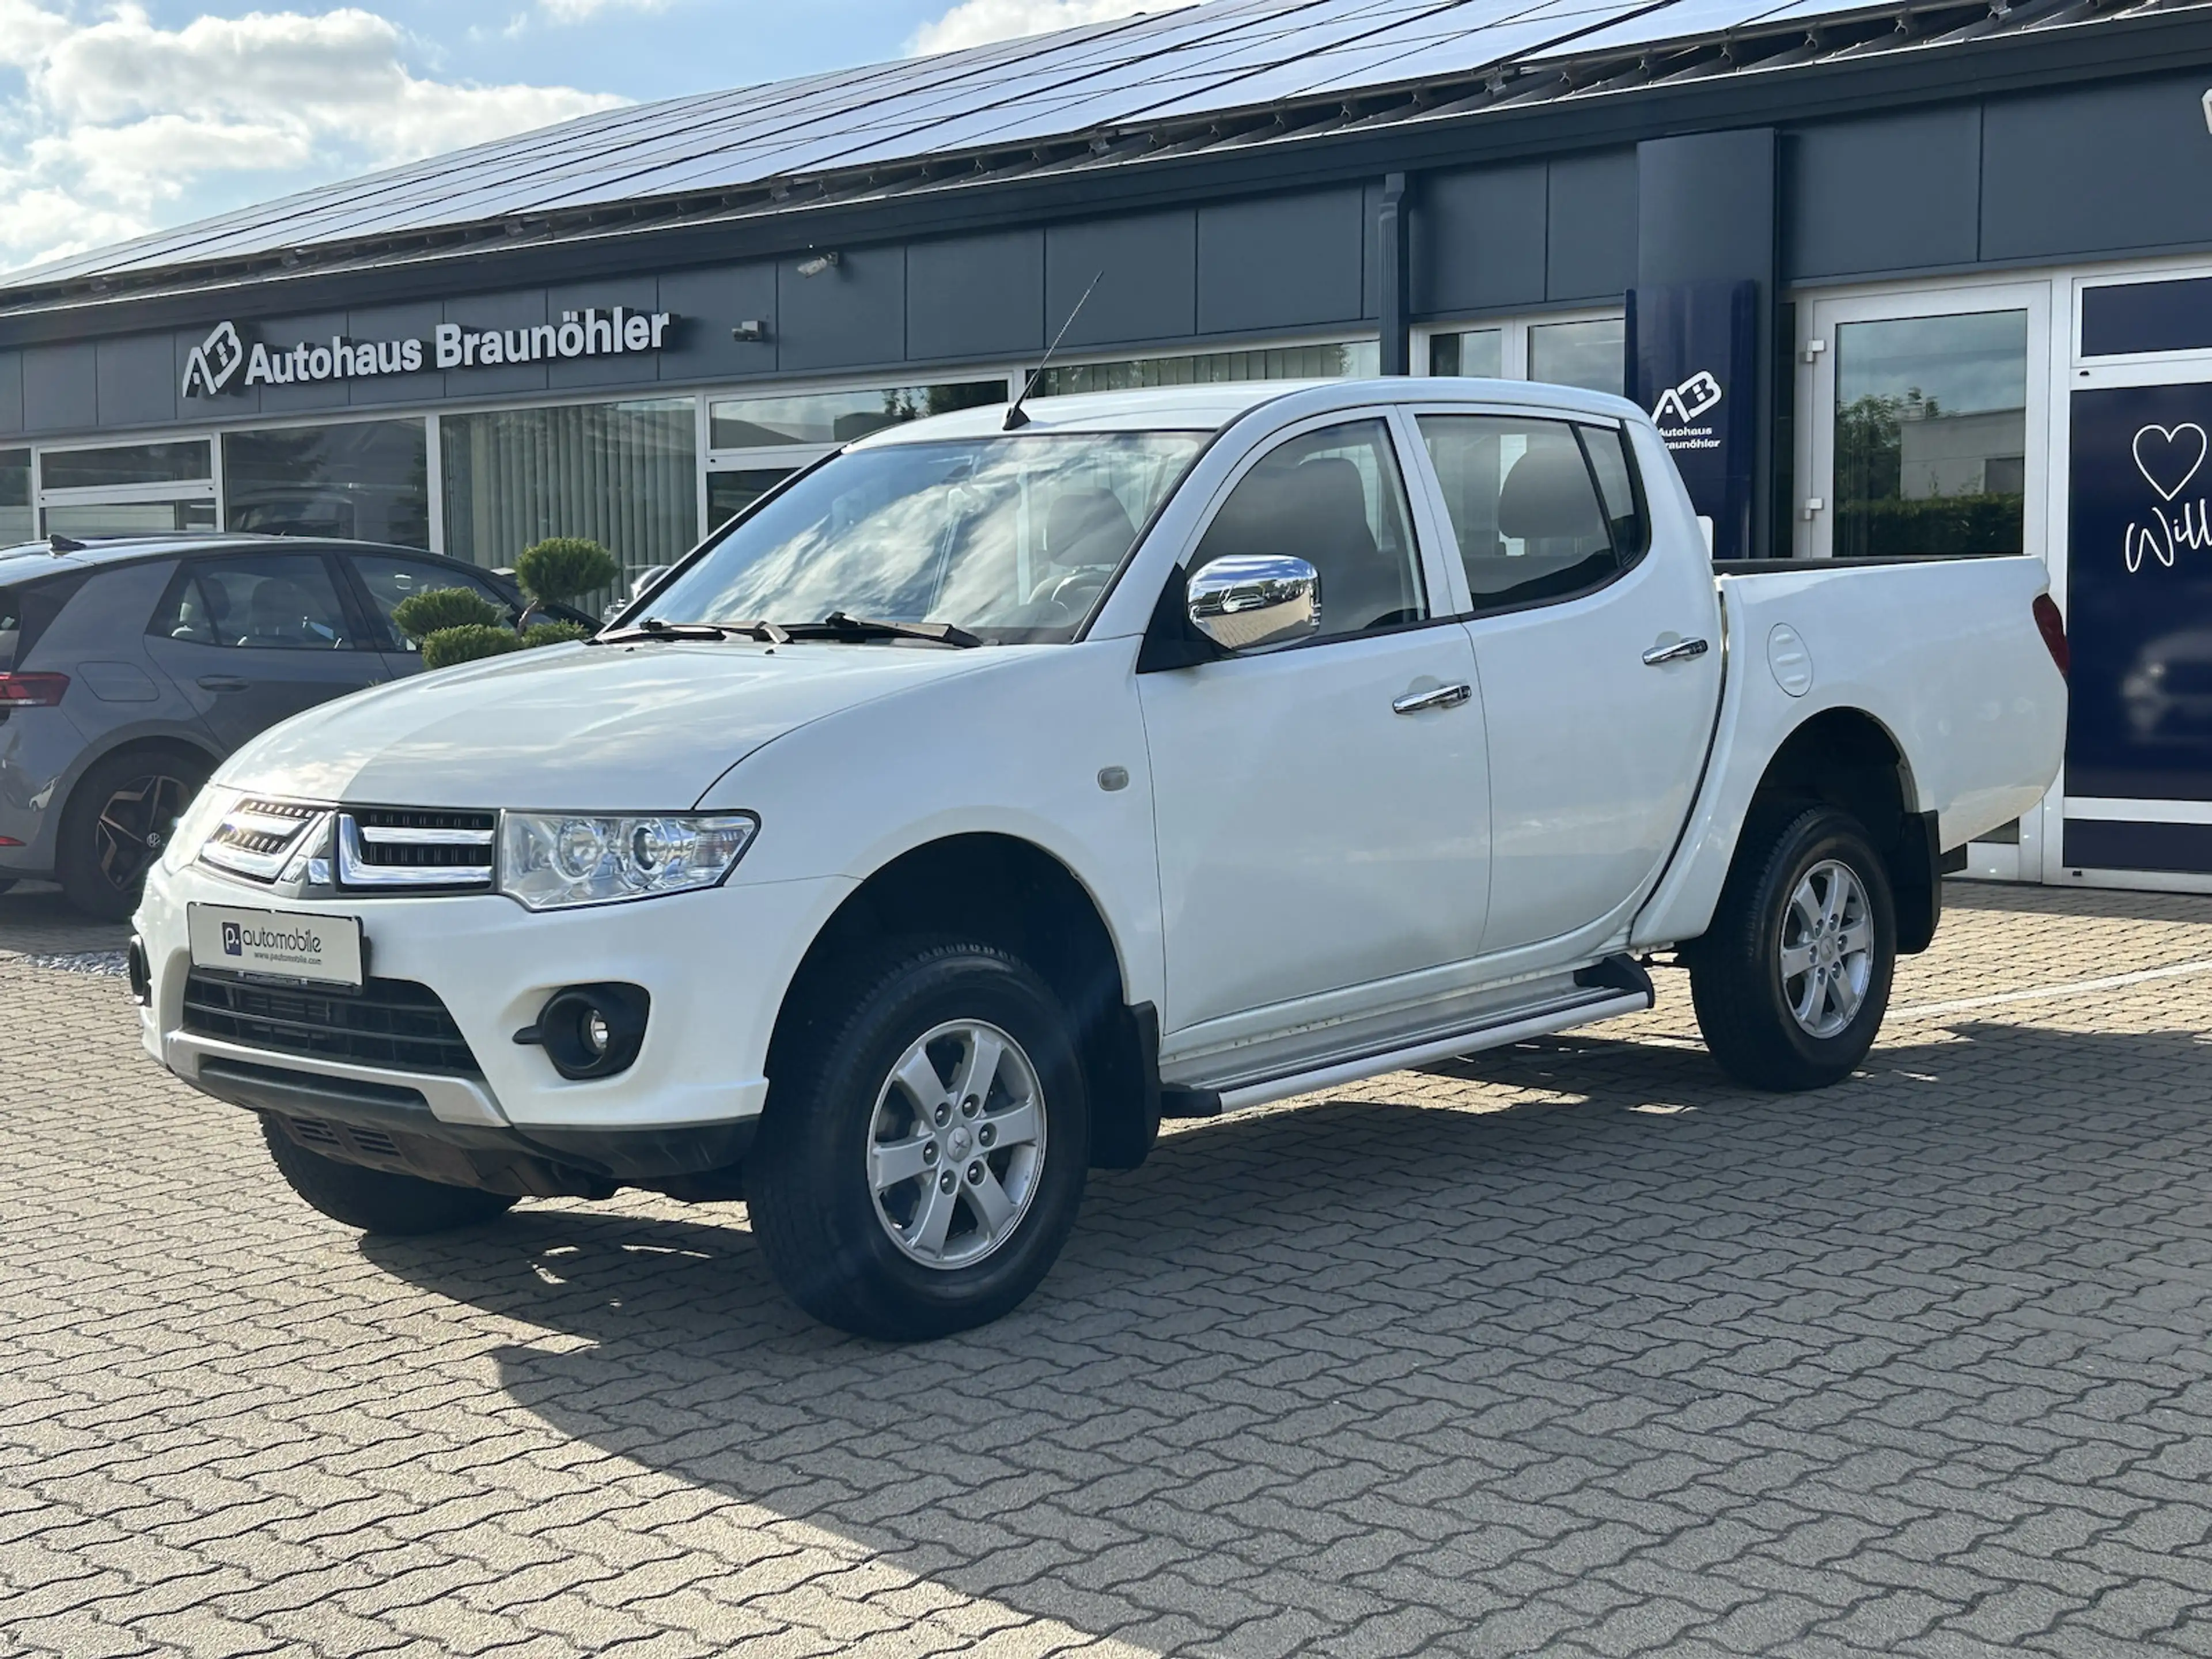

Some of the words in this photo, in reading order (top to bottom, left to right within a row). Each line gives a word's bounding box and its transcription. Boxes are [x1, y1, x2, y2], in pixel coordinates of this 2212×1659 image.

[245, 336, 422, 385] Autohaus
[435, 306, 669, 368] Braunöhler
[1659, 427, 1713, 437] Autohaus
[1665, 438, 1721, 449] raunöhler
[243, 928, 321, 953] automobile
